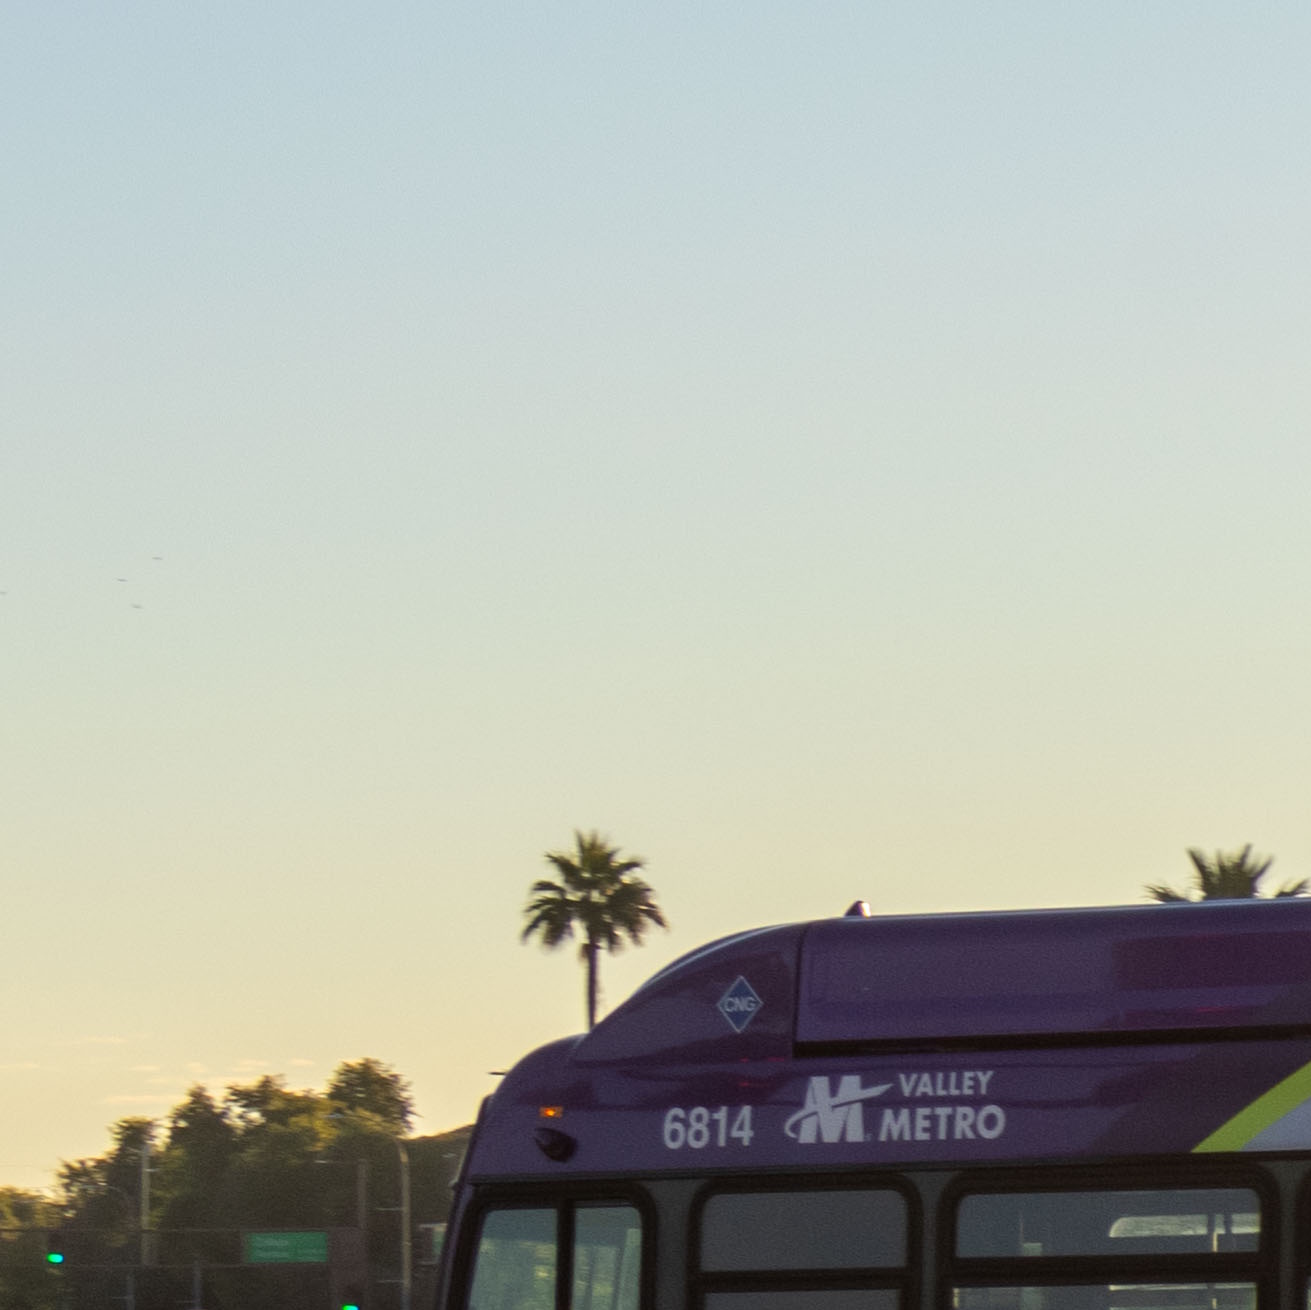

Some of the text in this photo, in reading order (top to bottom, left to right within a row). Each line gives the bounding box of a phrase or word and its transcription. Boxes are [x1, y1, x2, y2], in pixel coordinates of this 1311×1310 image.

[723, 996, 756, 1013] CNG
[898, 1070, 994, 1097] VALLEY
[662, 1105, 754, 1149] 6814
[879, 1104, 1006, 1141] METRO
